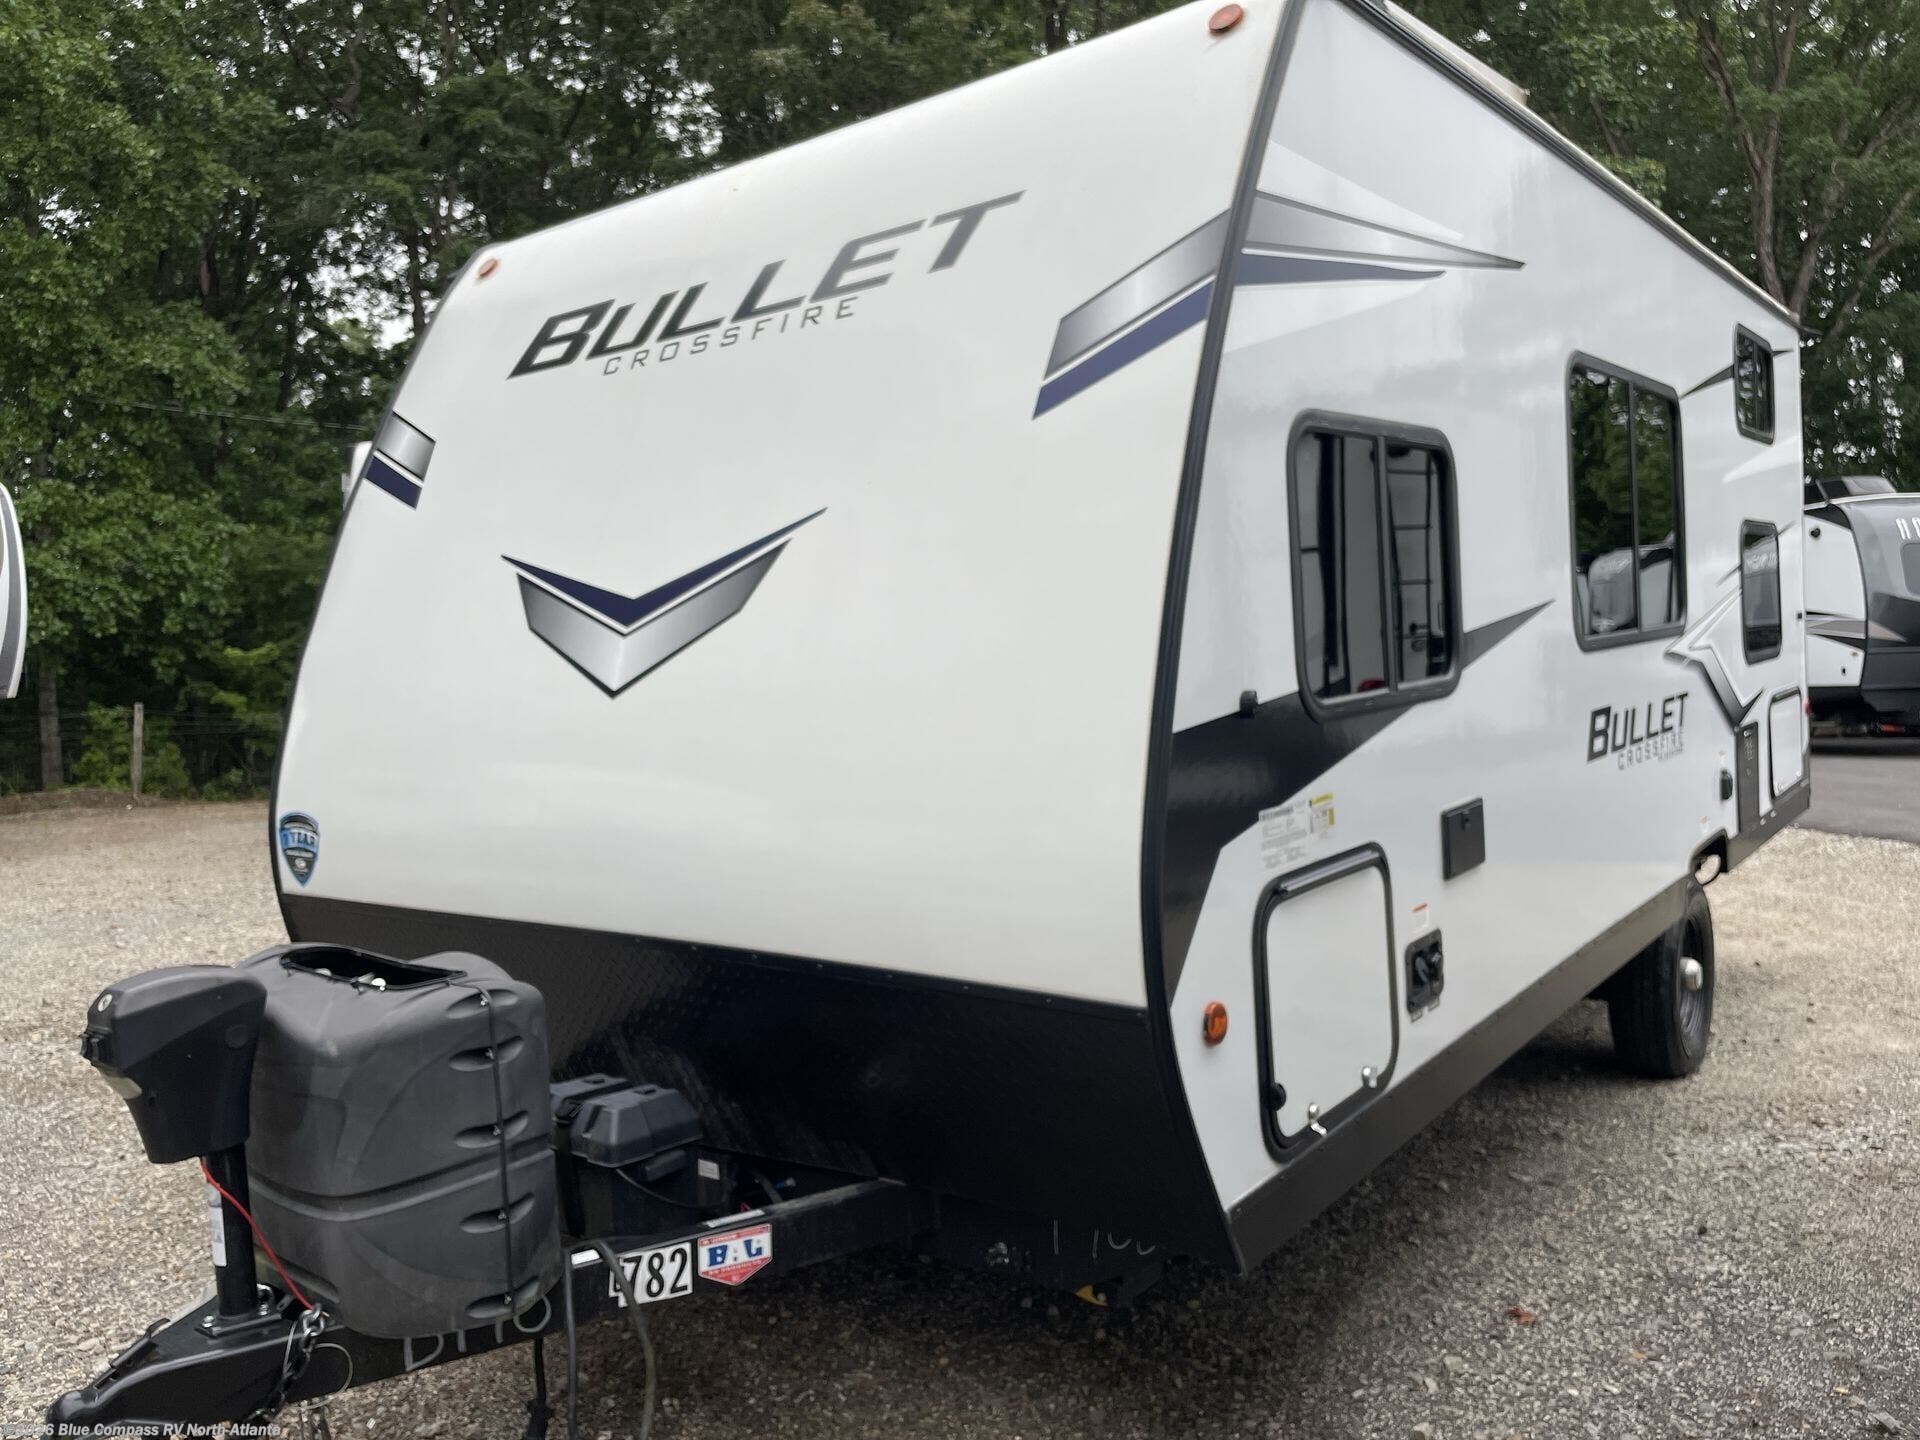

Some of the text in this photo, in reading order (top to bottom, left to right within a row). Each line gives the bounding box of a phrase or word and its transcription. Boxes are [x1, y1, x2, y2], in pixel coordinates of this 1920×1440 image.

[506, 190, 1026, 380] BULLET
[602, 297, 858, 377] CROSSFIRE
[1587, 692, 1688, 763] BULLET
